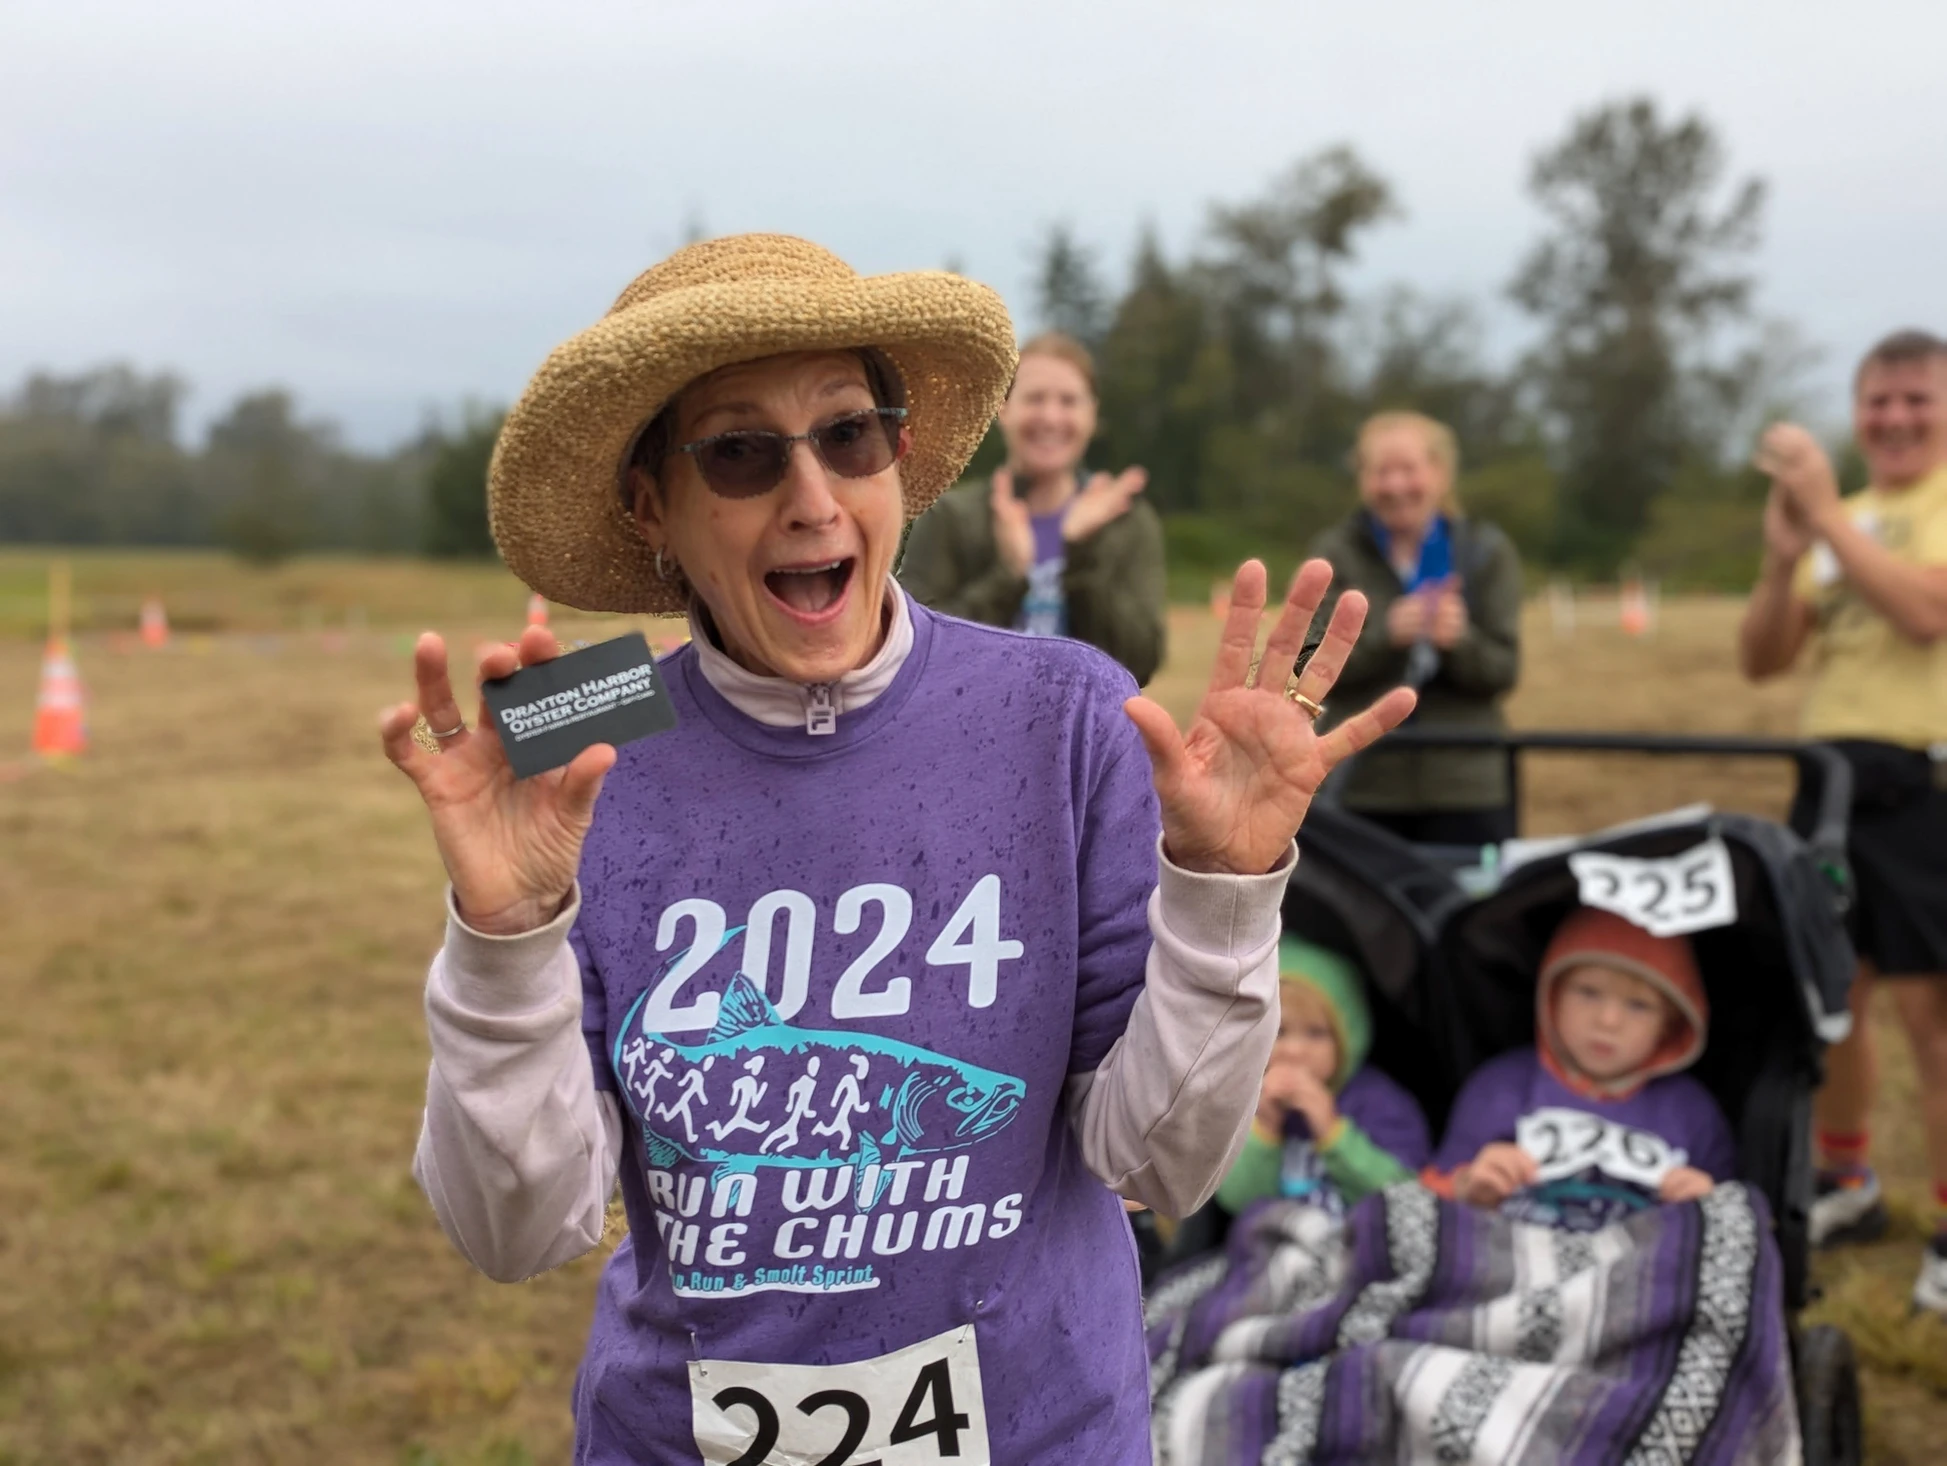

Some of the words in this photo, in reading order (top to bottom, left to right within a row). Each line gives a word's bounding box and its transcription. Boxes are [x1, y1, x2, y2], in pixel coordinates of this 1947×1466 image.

[500, 687, 581, 724] DRAYTON
[581, 663, 653, 697] HARBOR
[509, 704, 574, 734] OYSTER
[573, 677, 651, 712] COMPANY
[642, 873, 1025, 1034] 2024
[647, 1169, 758, 1218] RUN
[781, 1155, 971, 1213] WITH
[773, 1193, 1023, 1260] CHUMS
[689, 1270, 725, 1291] Run
[732, 1273, 748, 1290] &
[753, 1264, 808, 1286] Smolt
[812, 1264, 873, 1290] Sprint
[712, 1357, 971, 1466] 224
